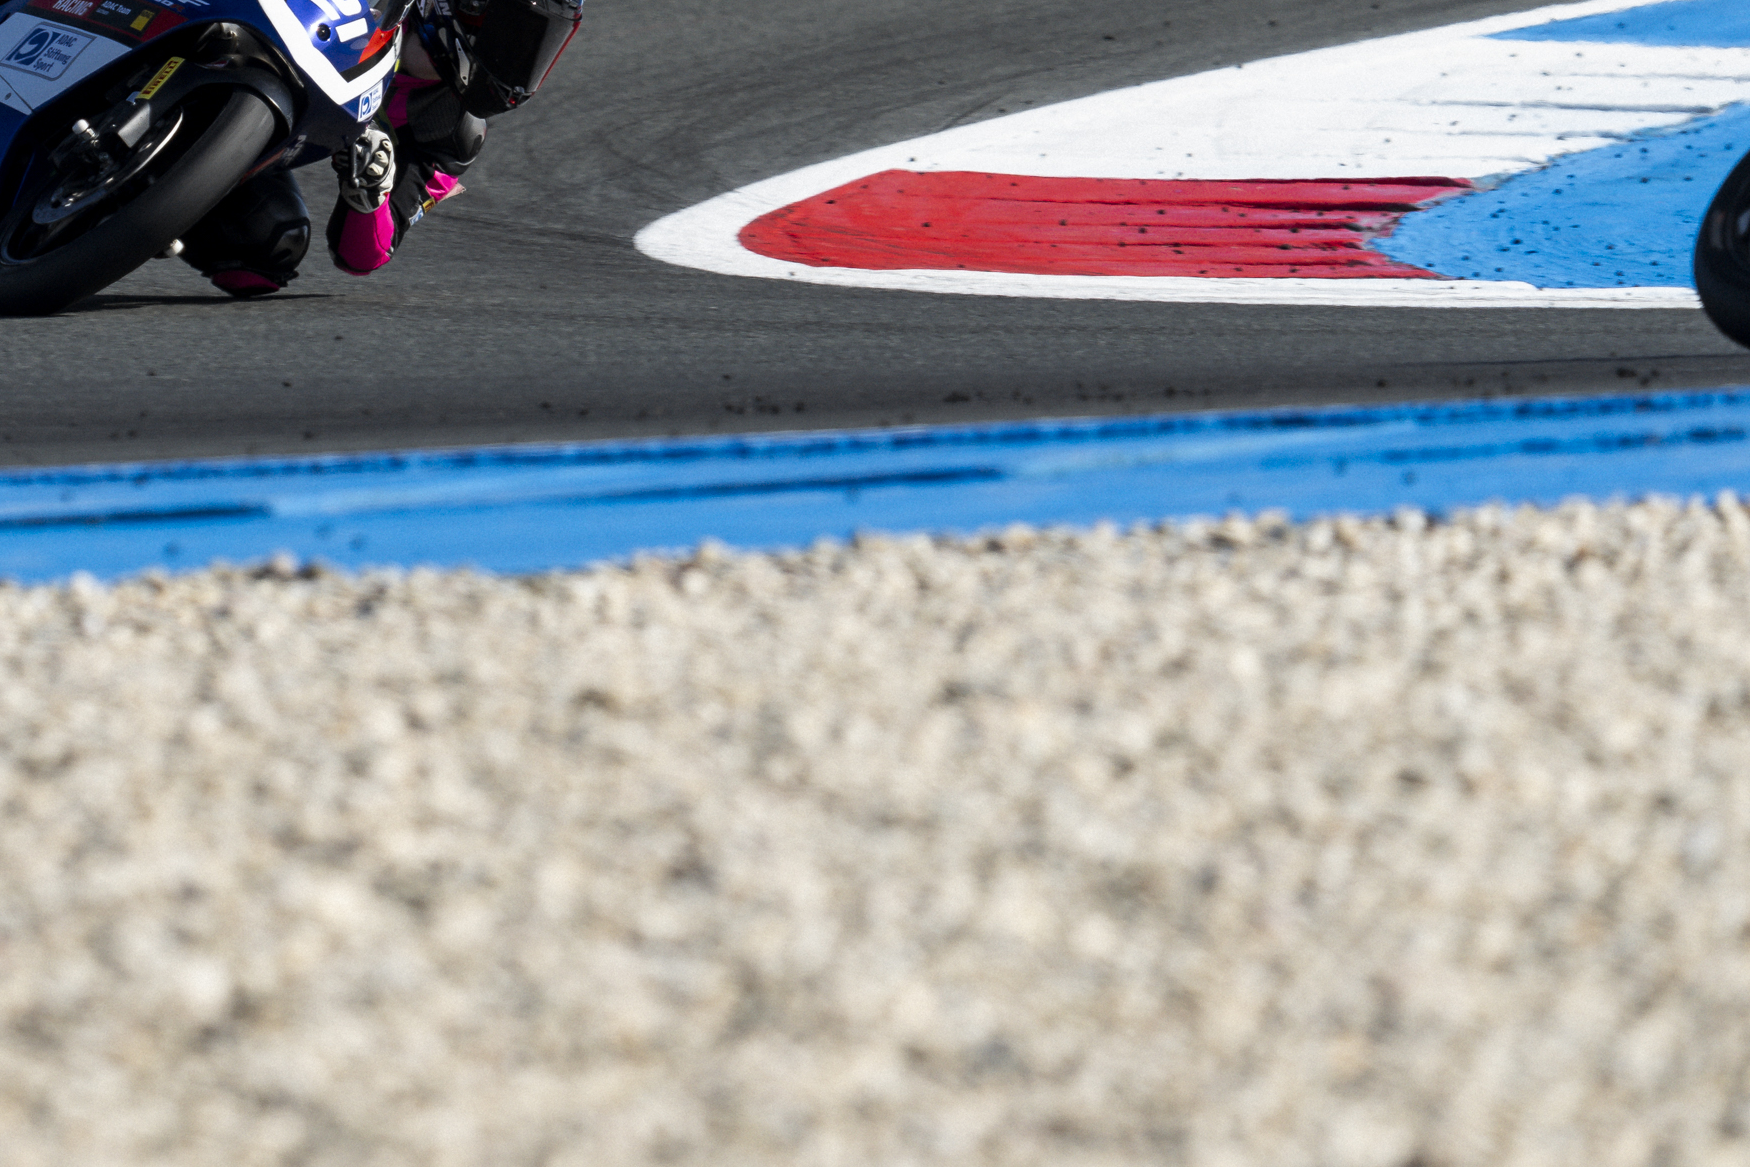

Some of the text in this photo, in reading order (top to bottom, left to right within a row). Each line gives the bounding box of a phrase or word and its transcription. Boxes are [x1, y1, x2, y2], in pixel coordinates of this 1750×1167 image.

[55, 34, 78, 48] ADAC
[44, 47, 72, 65] Stiftung
[33, 59, 55, 74] Sport
[141, 60, 179, 95] PIRELLI
